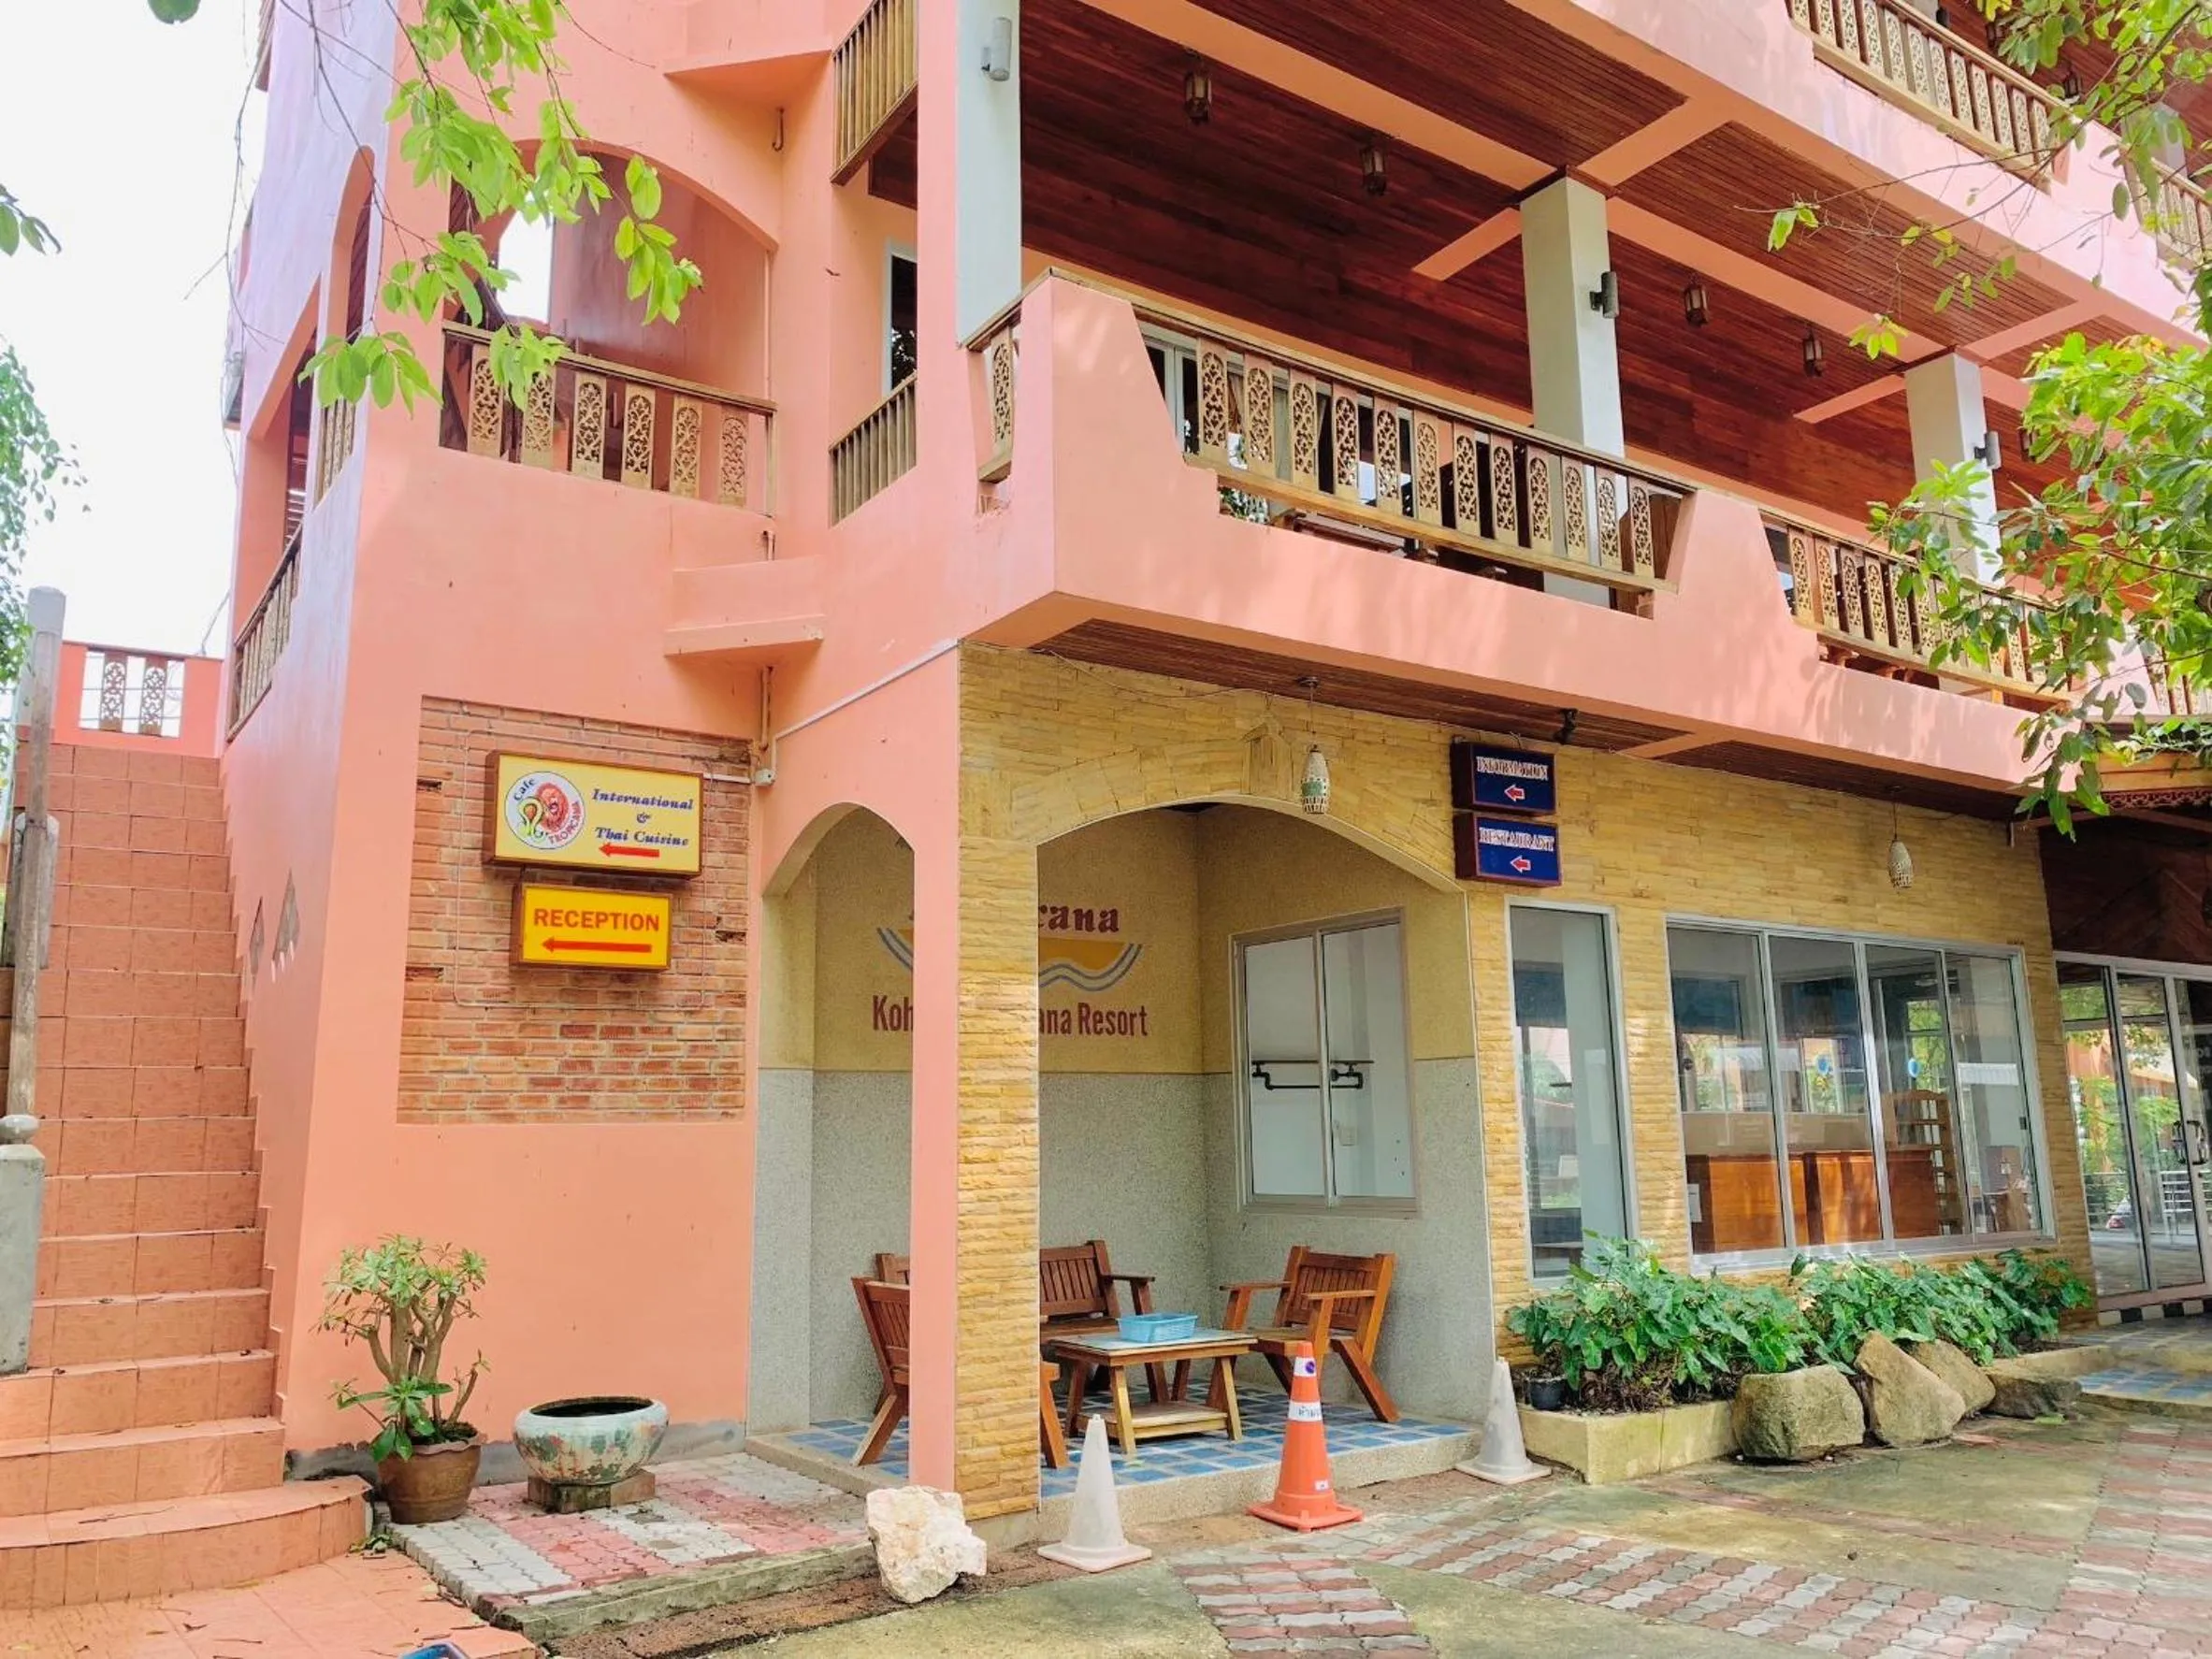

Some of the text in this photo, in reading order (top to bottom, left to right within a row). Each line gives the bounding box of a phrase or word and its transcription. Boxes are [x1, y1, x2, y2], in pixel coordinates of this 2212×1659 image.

[514, 778, 536, 801] Cafe
[592, 788, 694, 810] International
[636, 812, 652, 824] &
[595, 827, 689, 845] Thai Cuisine
[534, 908, 659, 931] RECEPTION
[1077, 1003, 1148, 1036] Resort
